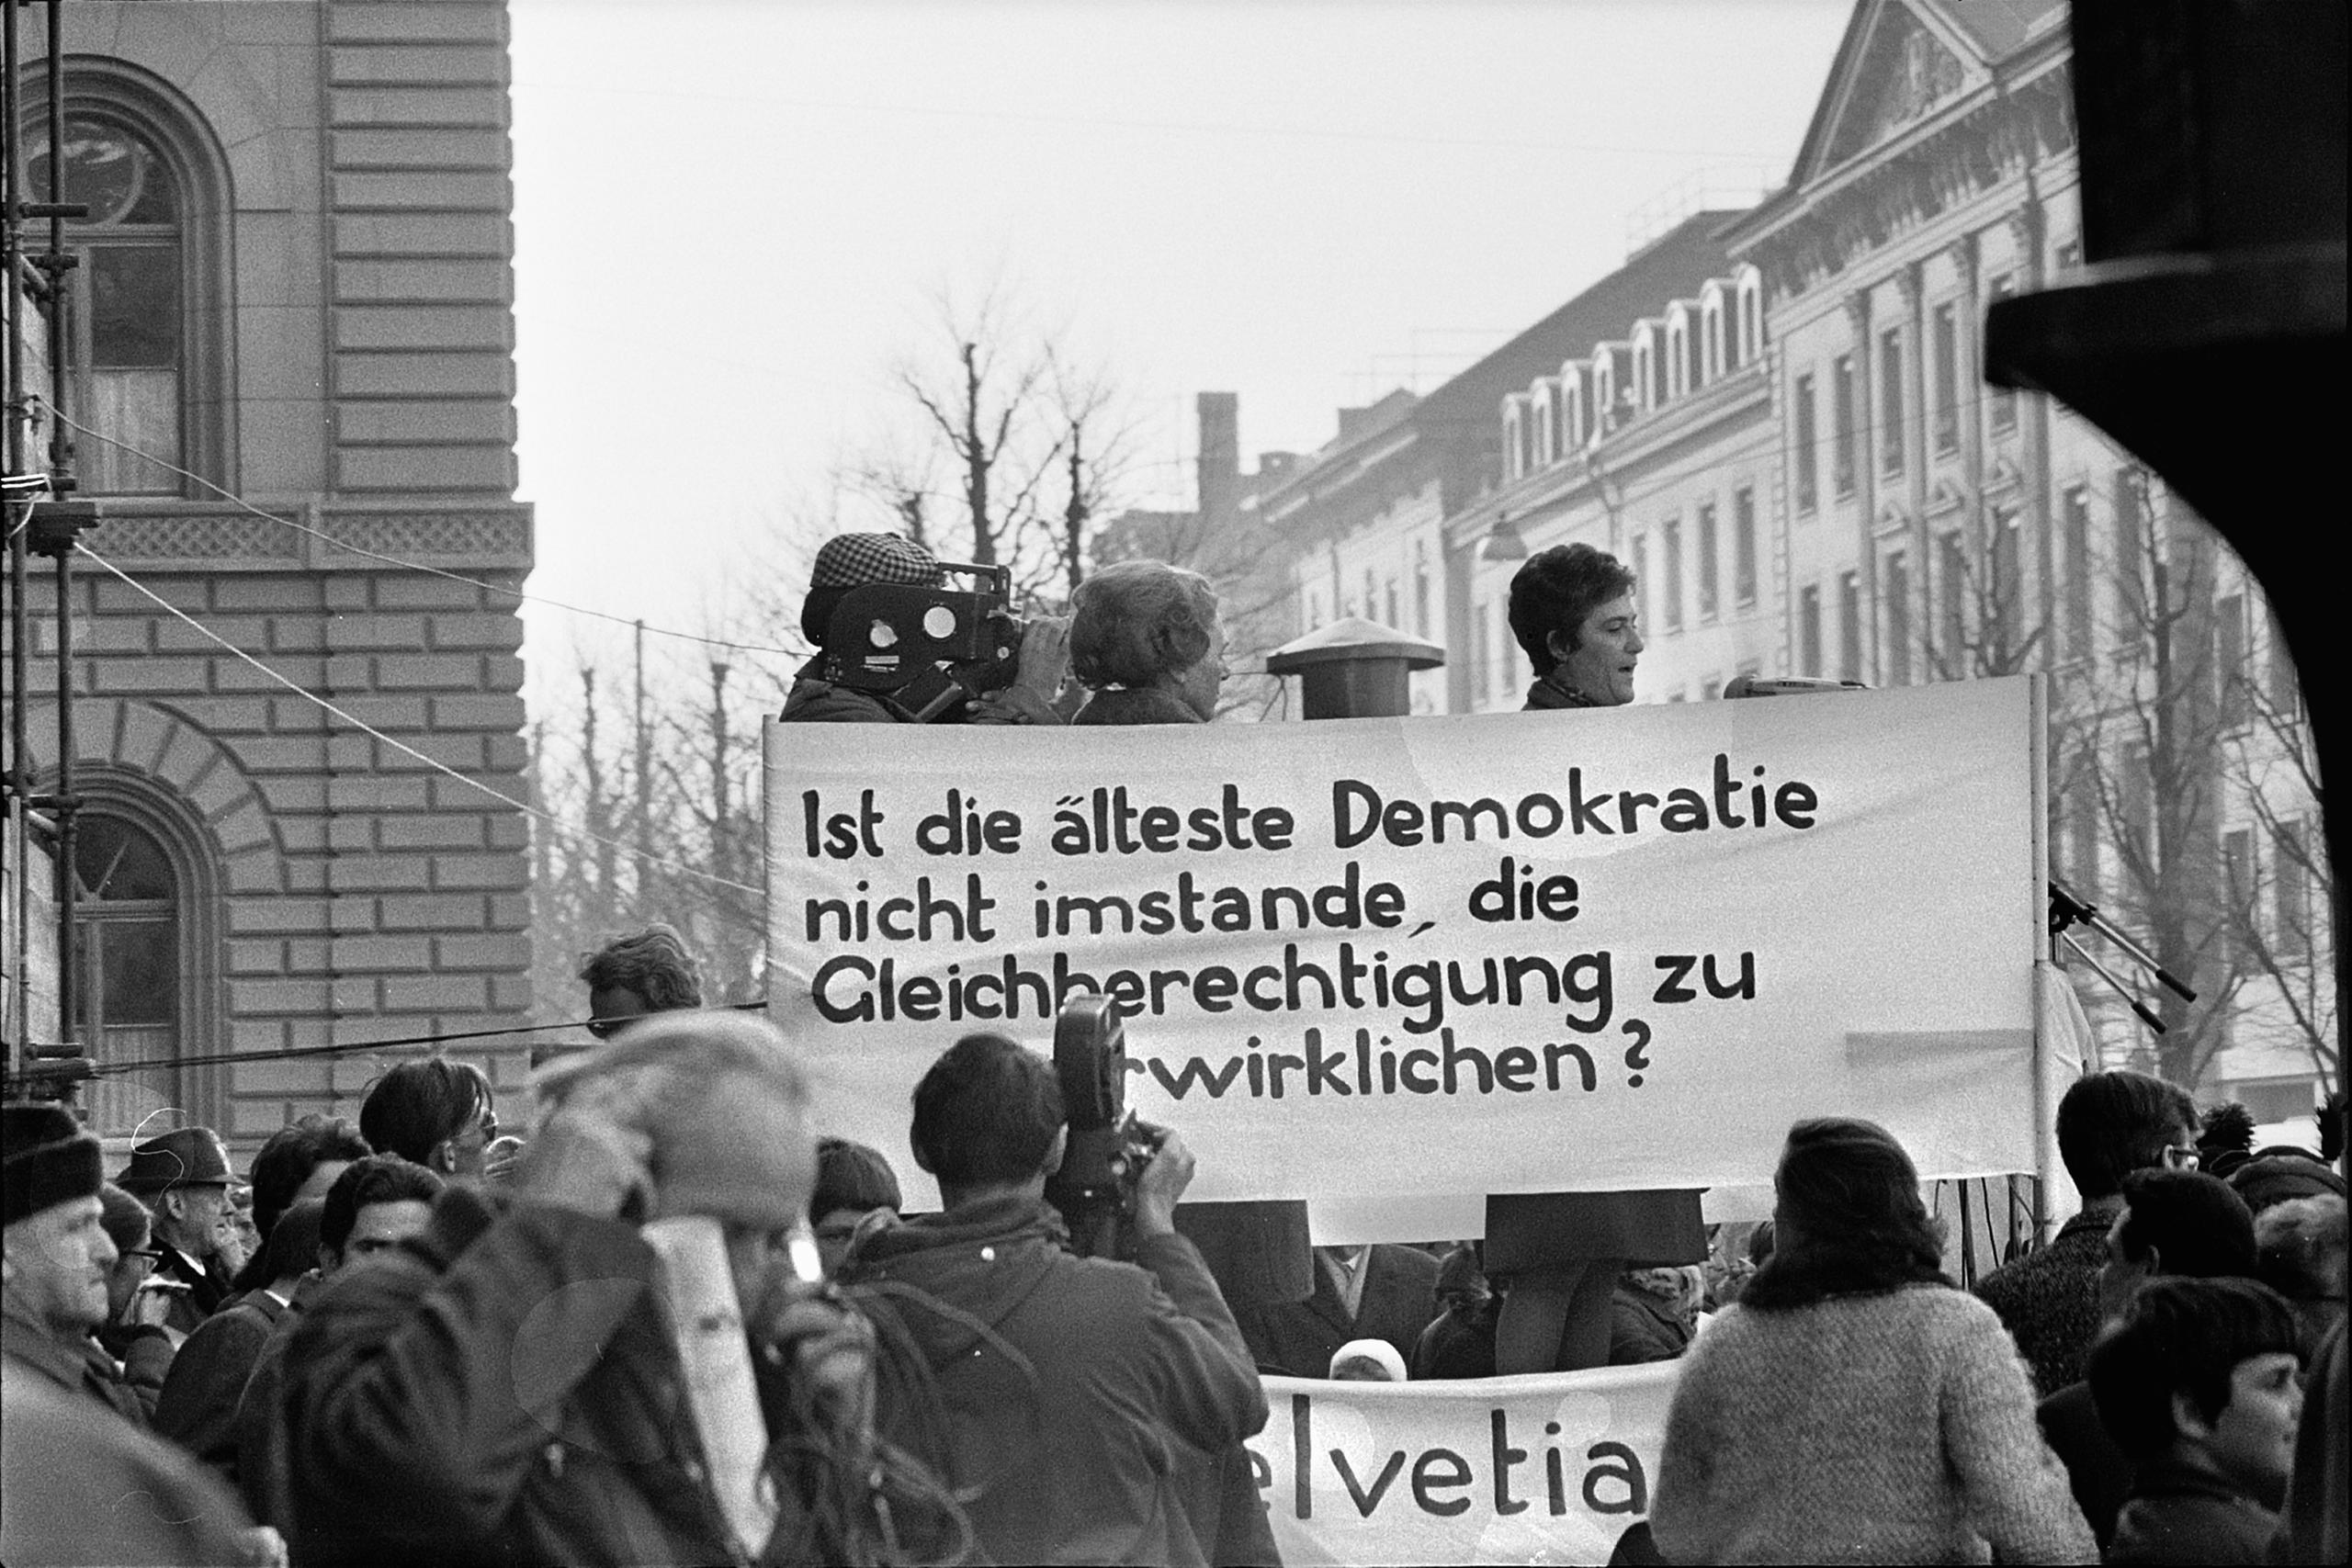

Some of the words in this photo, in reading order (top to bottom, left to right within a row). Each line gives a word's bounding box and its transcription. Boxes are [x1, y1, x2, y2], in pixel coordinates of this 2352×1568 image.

[802, 787, 885, 860] Ist
[915, 787, 1022, 856] die
[1050, 783, 1295, 856] älteste
[1331, 753, 1820, 850] Demokratie
[806, 871, 997, 943] nicht
[1467, 855, 1580, 924] die
[808, 942, 1614, 1035] Gleichberechtigung
[1651, 951, 1757, 1005] zu
